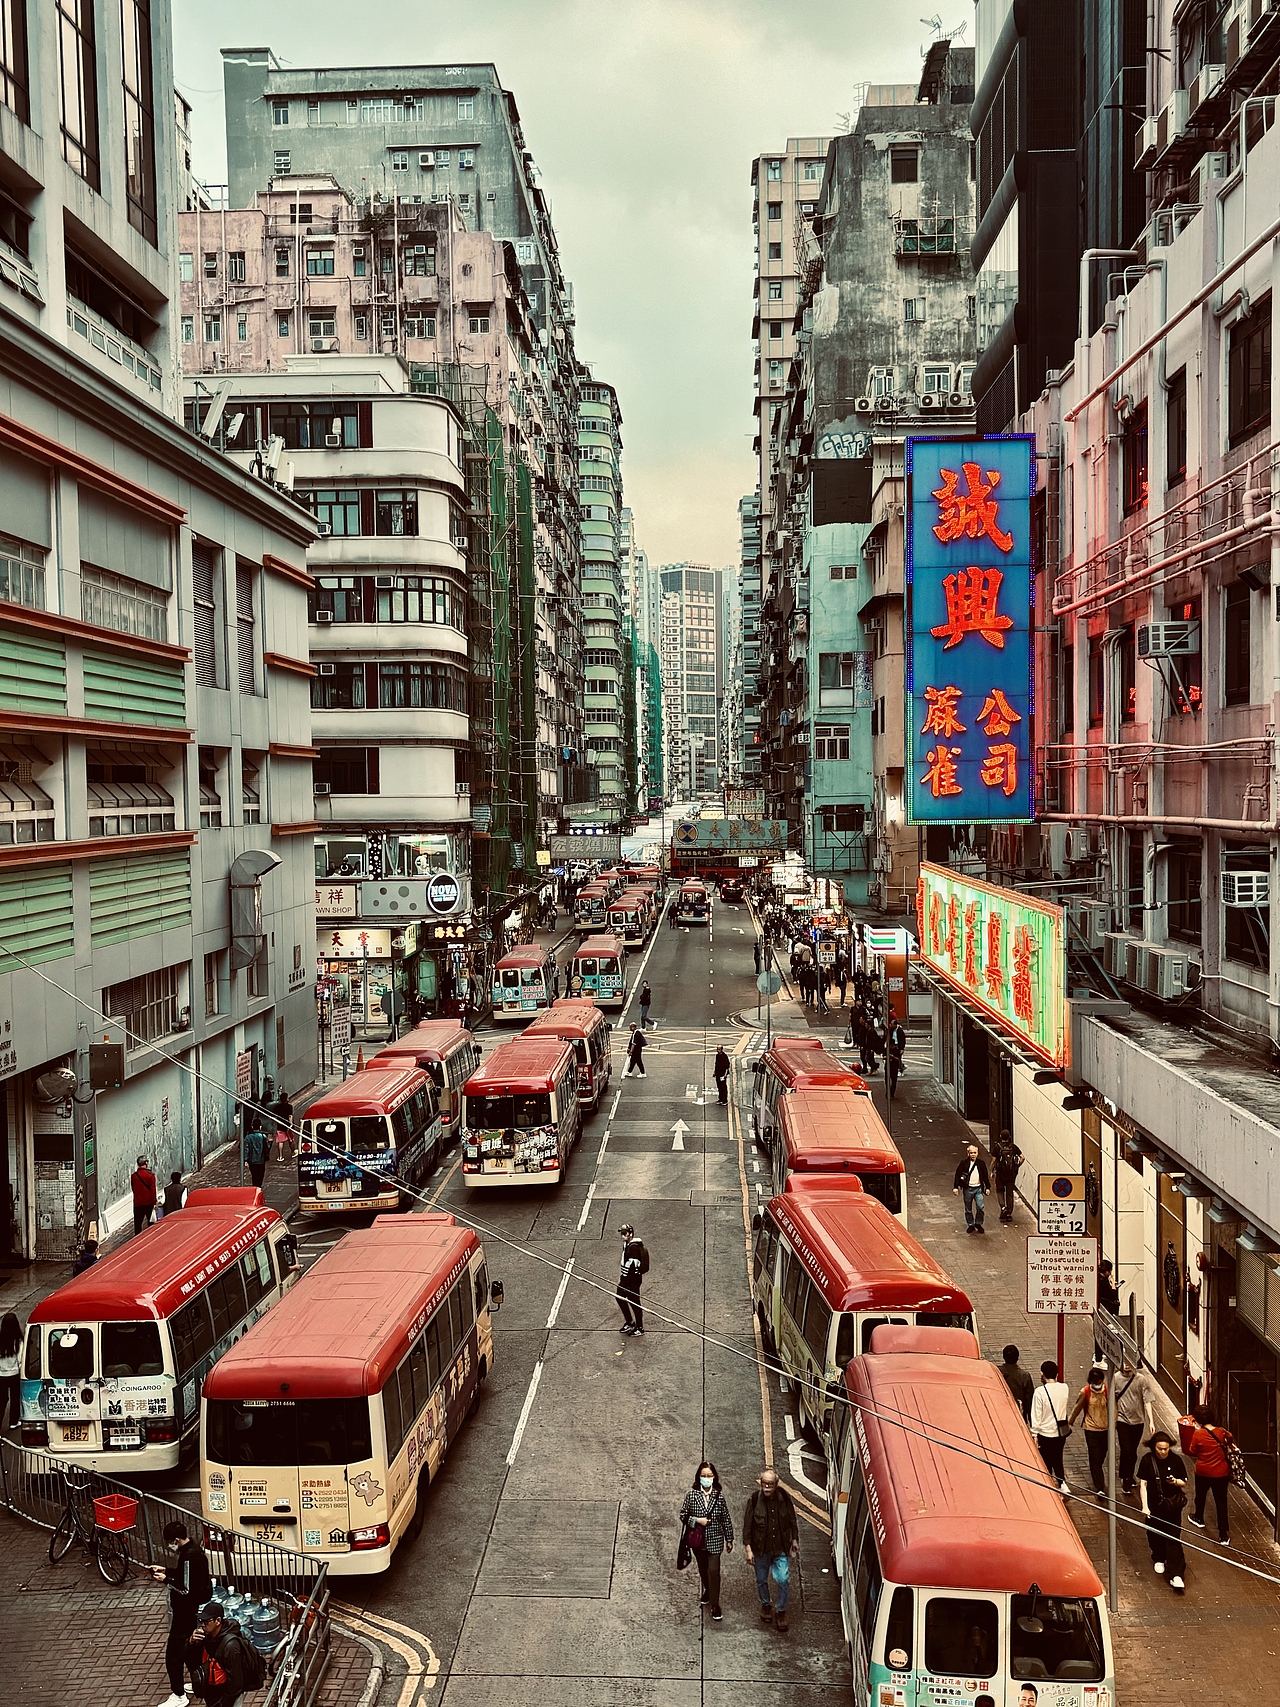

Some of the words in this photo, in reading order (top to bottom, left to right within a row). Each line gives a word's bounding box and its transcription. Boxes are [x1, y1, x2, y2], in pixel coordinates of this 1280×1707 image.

[929, 461, 1014, 650] 誠興
[975, 688, 1022, 796] 公司
[430, 884, 457, 896] NOVA
[332, 906, 353, 914] SHOP
[331, 931, 371, 947] 天堂
[1068, 1203, 1077, 1214] 7
[1069, 1220, 1083, 1232] 12
[1034, 1248, 1064, 1256] waiting
[180, 1279, 196, 1296] PUBLIC
[194, 1270, 207, 1284] LIGHT
[205, 1263, 215, 1275] BUS
[218, 1249, 232, 1264] SEATS
[1040, 1274, 1085, 1284] 停車等候
[1040, 1287, 1085, 1297] 會被檢控
[1034, 1300, 1090, 1310] 而不予警告
[407, 1323, 418, 1343] PUBLIC
[120, 1384, 163, 1393] COINGAROO
[124, 1399, 148, 1412] 香港
[148, 1404, 168, 1415] 學院
[69, 1425, 83, 1434] GN
[63, 1432, 89, 1442] 4627
[256, 1531, 283, 1540] 5574
